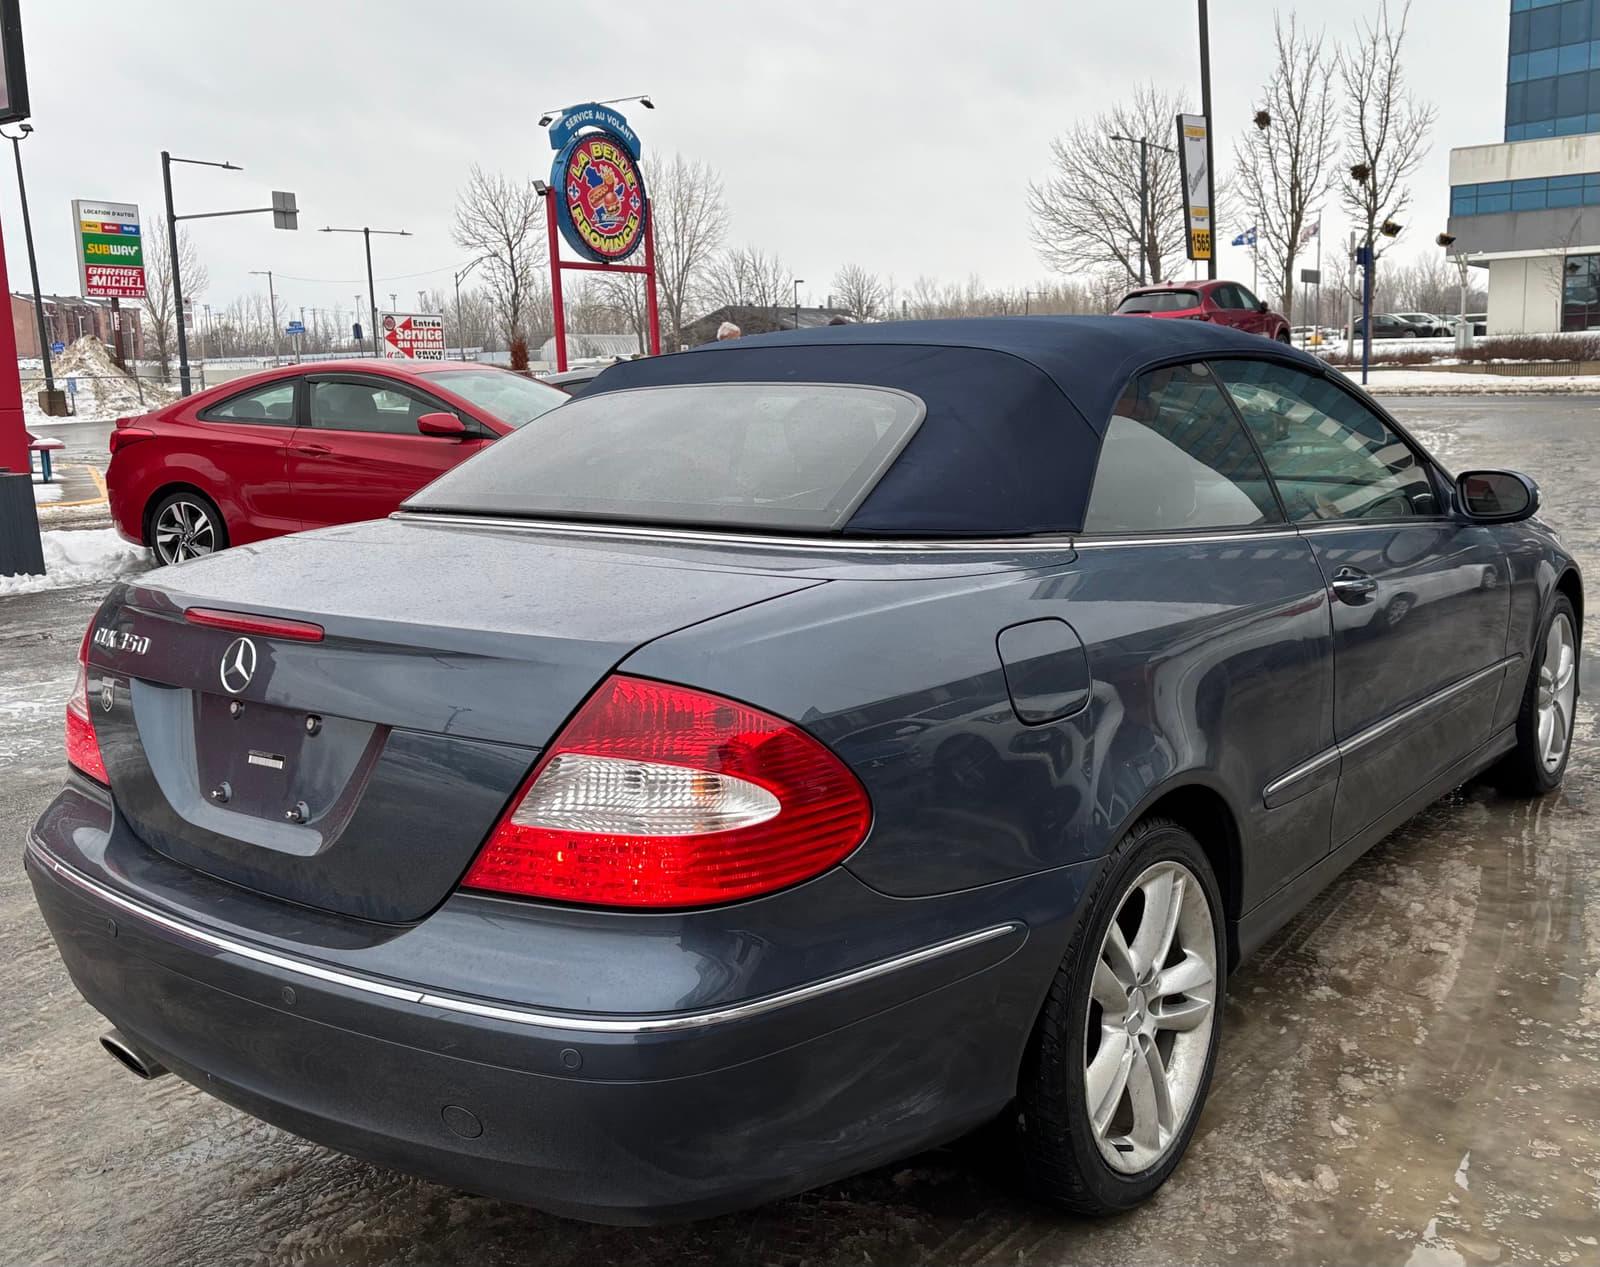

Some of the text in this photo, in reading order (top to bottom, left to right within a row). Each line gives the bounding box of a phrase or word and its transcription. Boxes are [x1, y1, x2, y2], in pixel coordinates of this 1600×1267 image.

[565, 110, 634, 141] SERVICE AU VOLANT
[571, 142, 637, 190] LA BELLE
[84, 208, 111, 216] LOCATION
[570, 203, 639, 252] PROVINCE
[86, 243, 139, 256] SUBWAY
[88, 267, 141, 277] GARAGE
[92, 276, 144, 288] MICHEL
[413, 319, 441, 328] Entrée
[396, 328, 442, 340] Service
[397, 340, 443, 349] au volant
[93, 626, 152, 655] CLK 350
